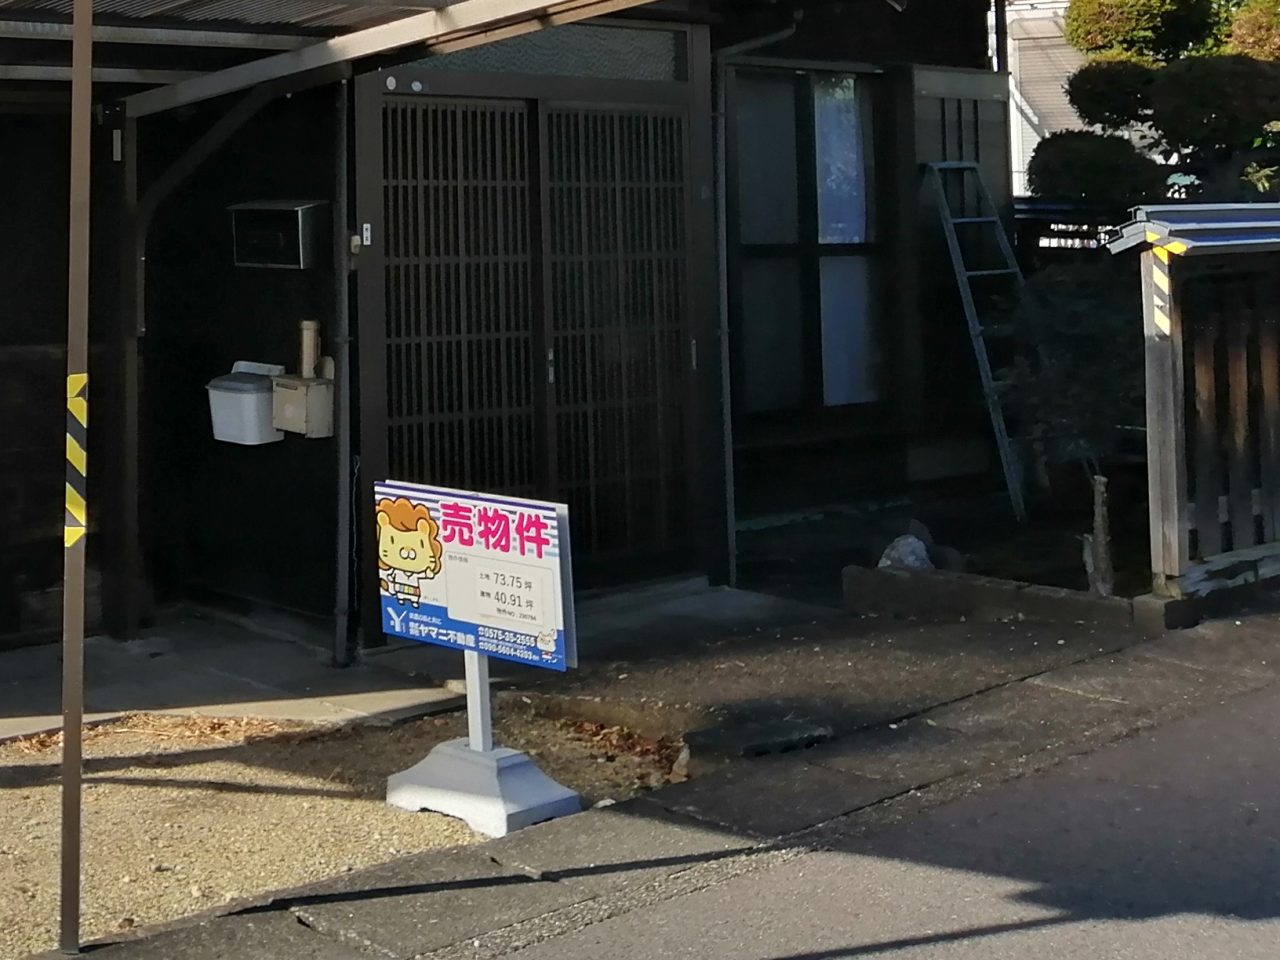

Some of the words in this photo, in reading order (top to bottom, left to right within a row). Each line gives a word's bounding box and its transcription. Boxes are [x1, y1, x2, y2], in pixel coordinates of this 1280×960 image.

[440, 502, 551, 559] 売物件
[493, 573, 522, 589] 73.75
[524, 580, 533, 591] 坪
[494, 591, 523, 607] 40.91
[525, 599, 534, 610] 坪
